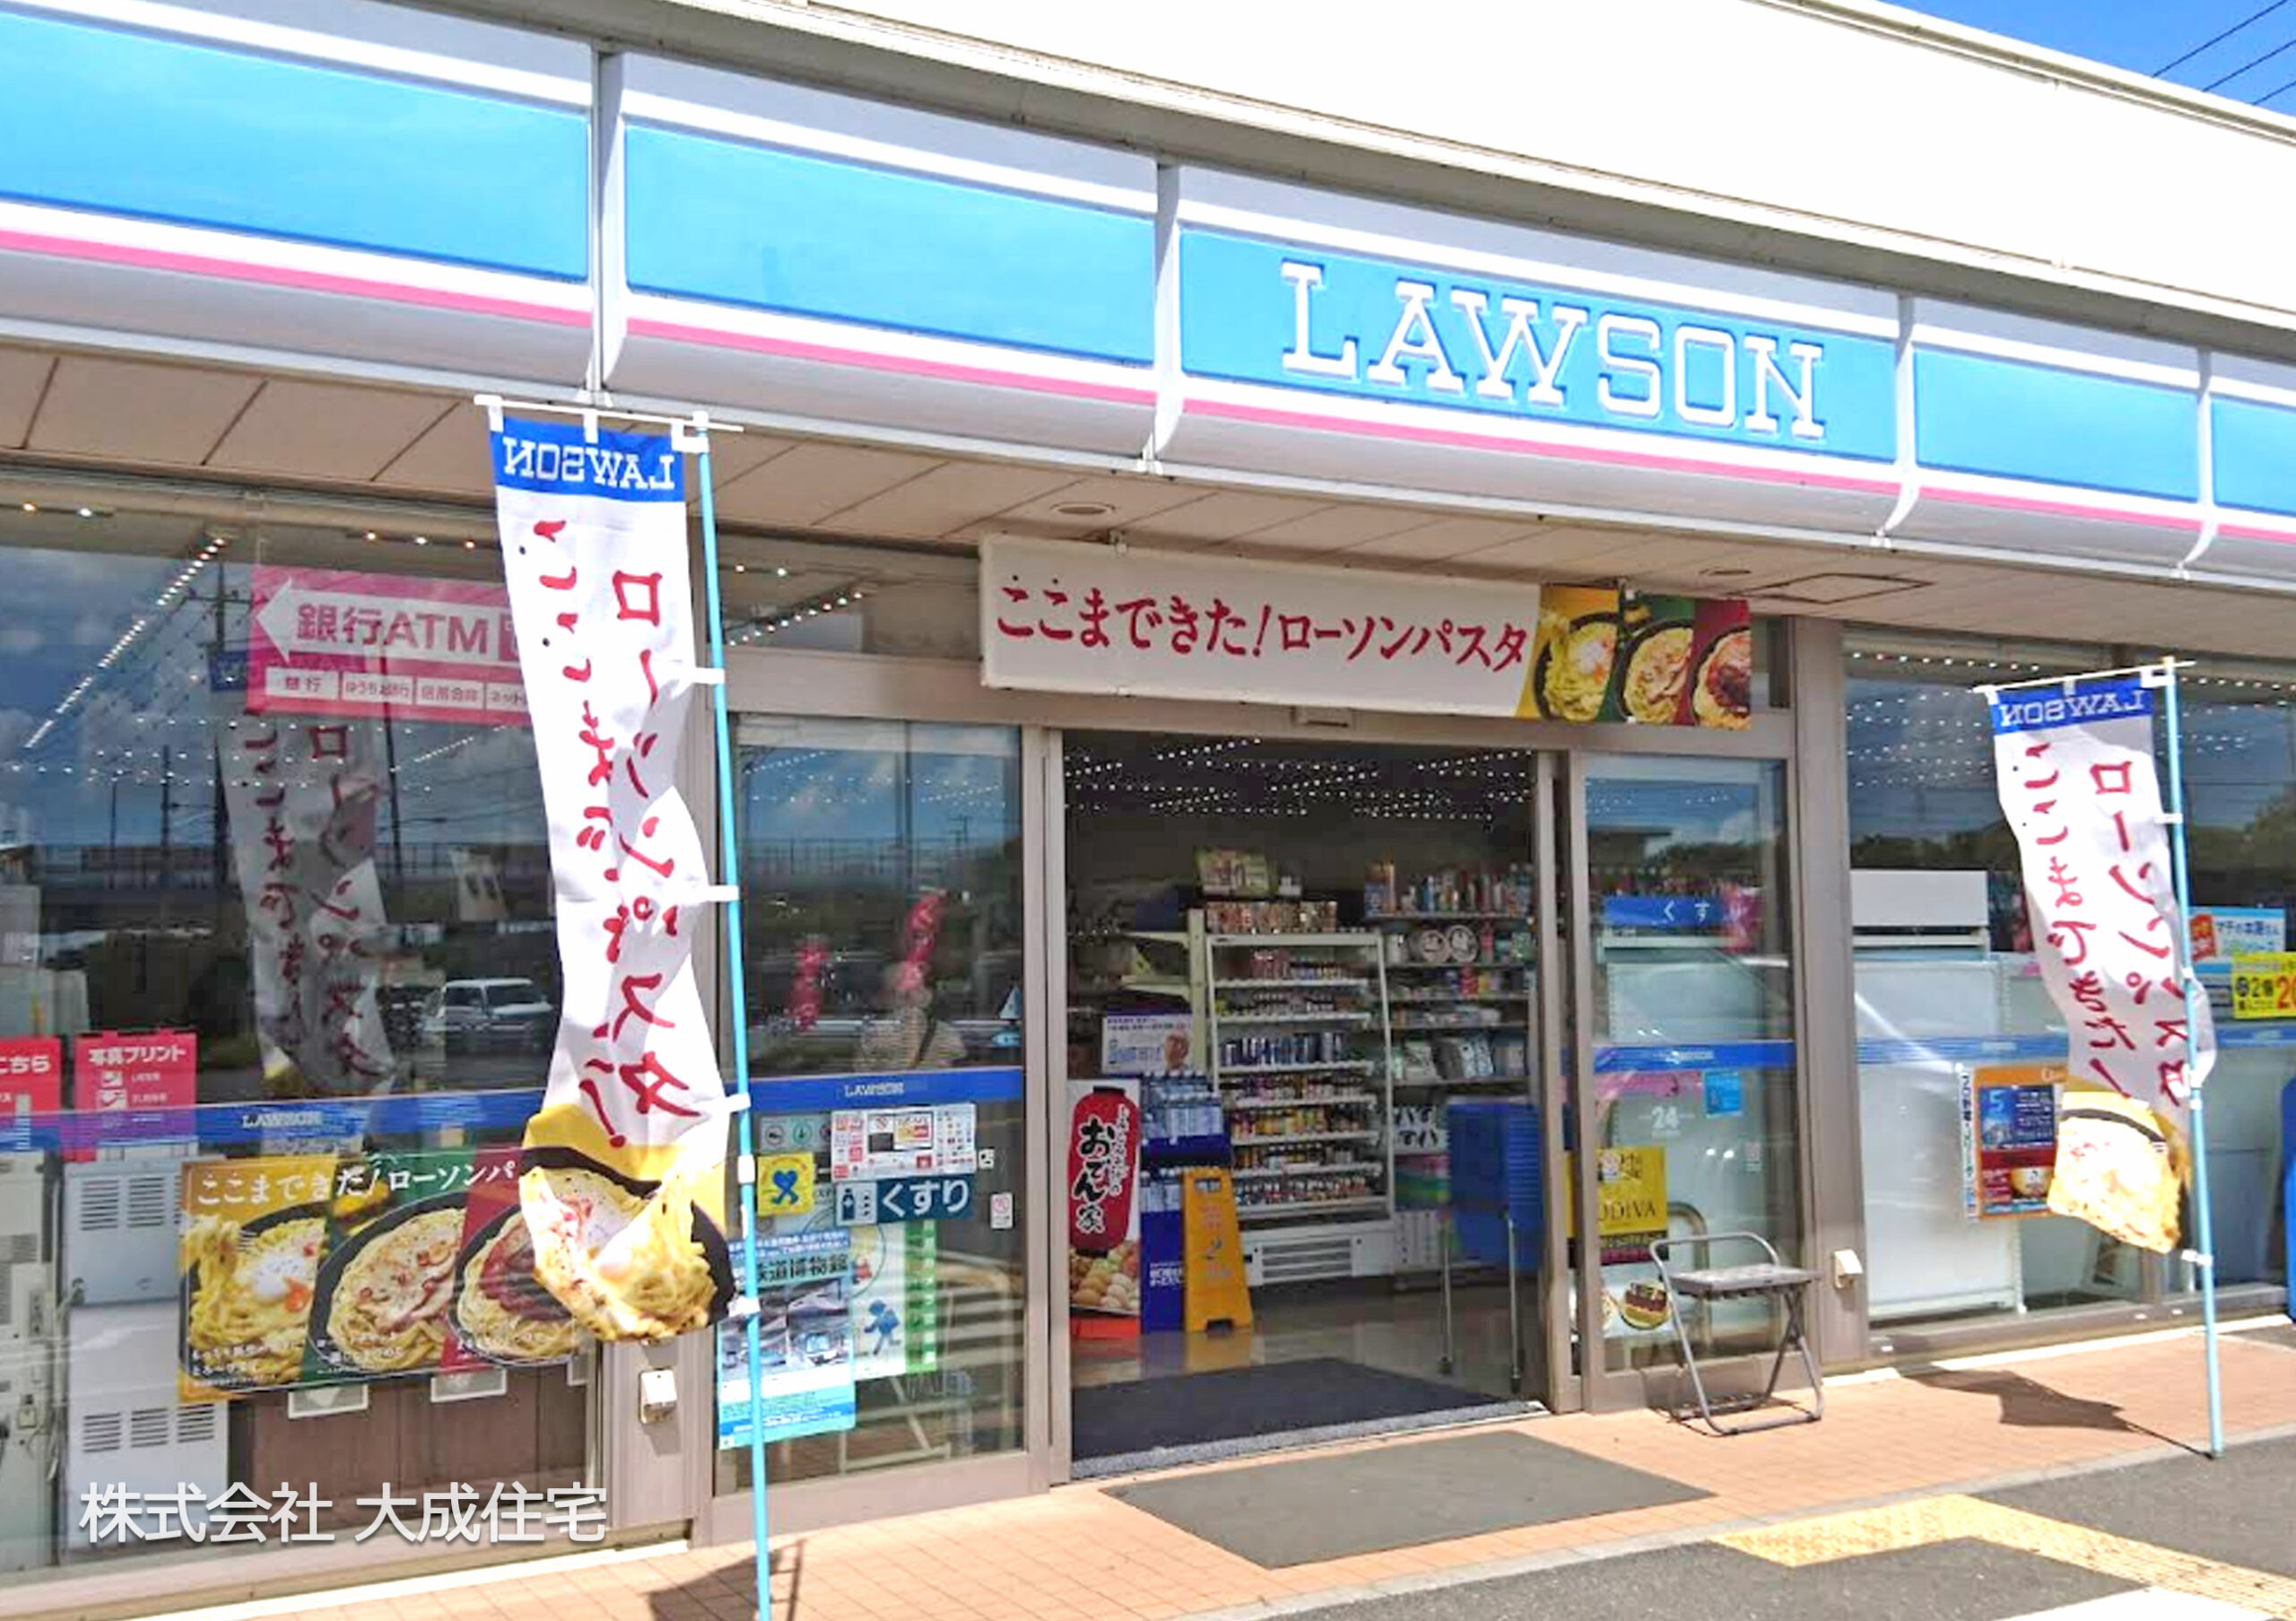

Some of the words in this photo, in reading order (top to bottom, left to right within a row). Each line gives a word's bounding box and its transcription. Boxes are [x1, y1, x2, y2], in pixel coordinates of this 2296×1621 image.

[1281, 259, 1826, 439] LAWSON
[295, 602, 490, 655] 銀行ATM
[197, 1159, 517, 1206] ここまできた!ローソンパ
[881, 1178, 970, 1217] くすり
